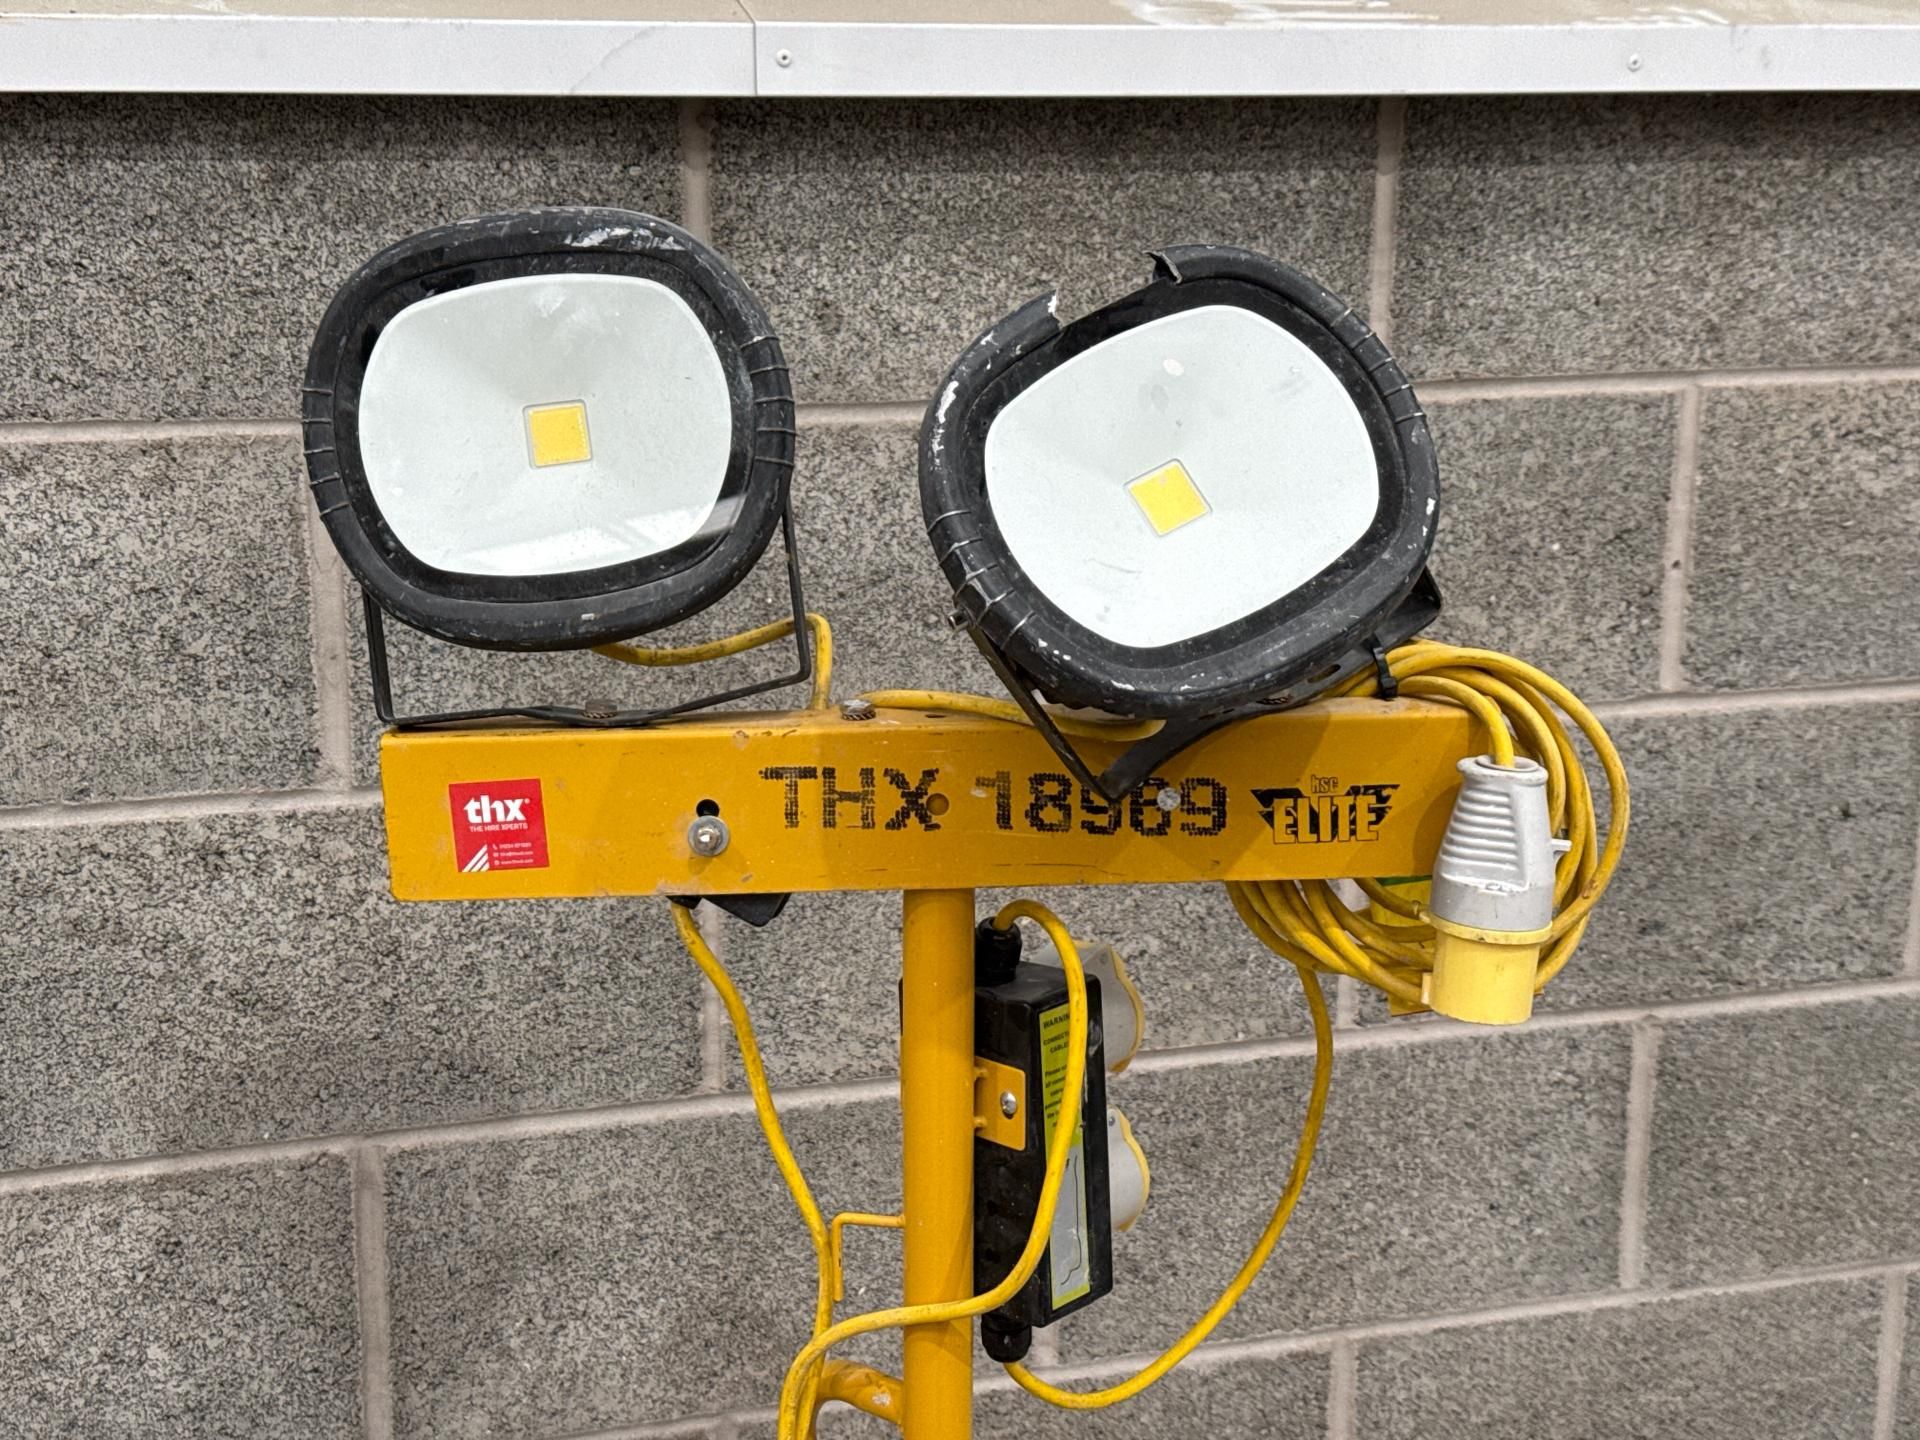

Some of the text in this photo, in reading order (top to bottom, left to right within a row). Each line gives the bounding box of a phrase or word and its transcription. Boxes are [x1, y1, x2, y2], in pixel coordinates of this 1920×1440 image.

[463, 795, 527, 823] thx
[758, 766, 941, 832] THX
[1272, 795, 1379, 844] ELITE
[1043, 1013, 1070, 1029] WARNIN
